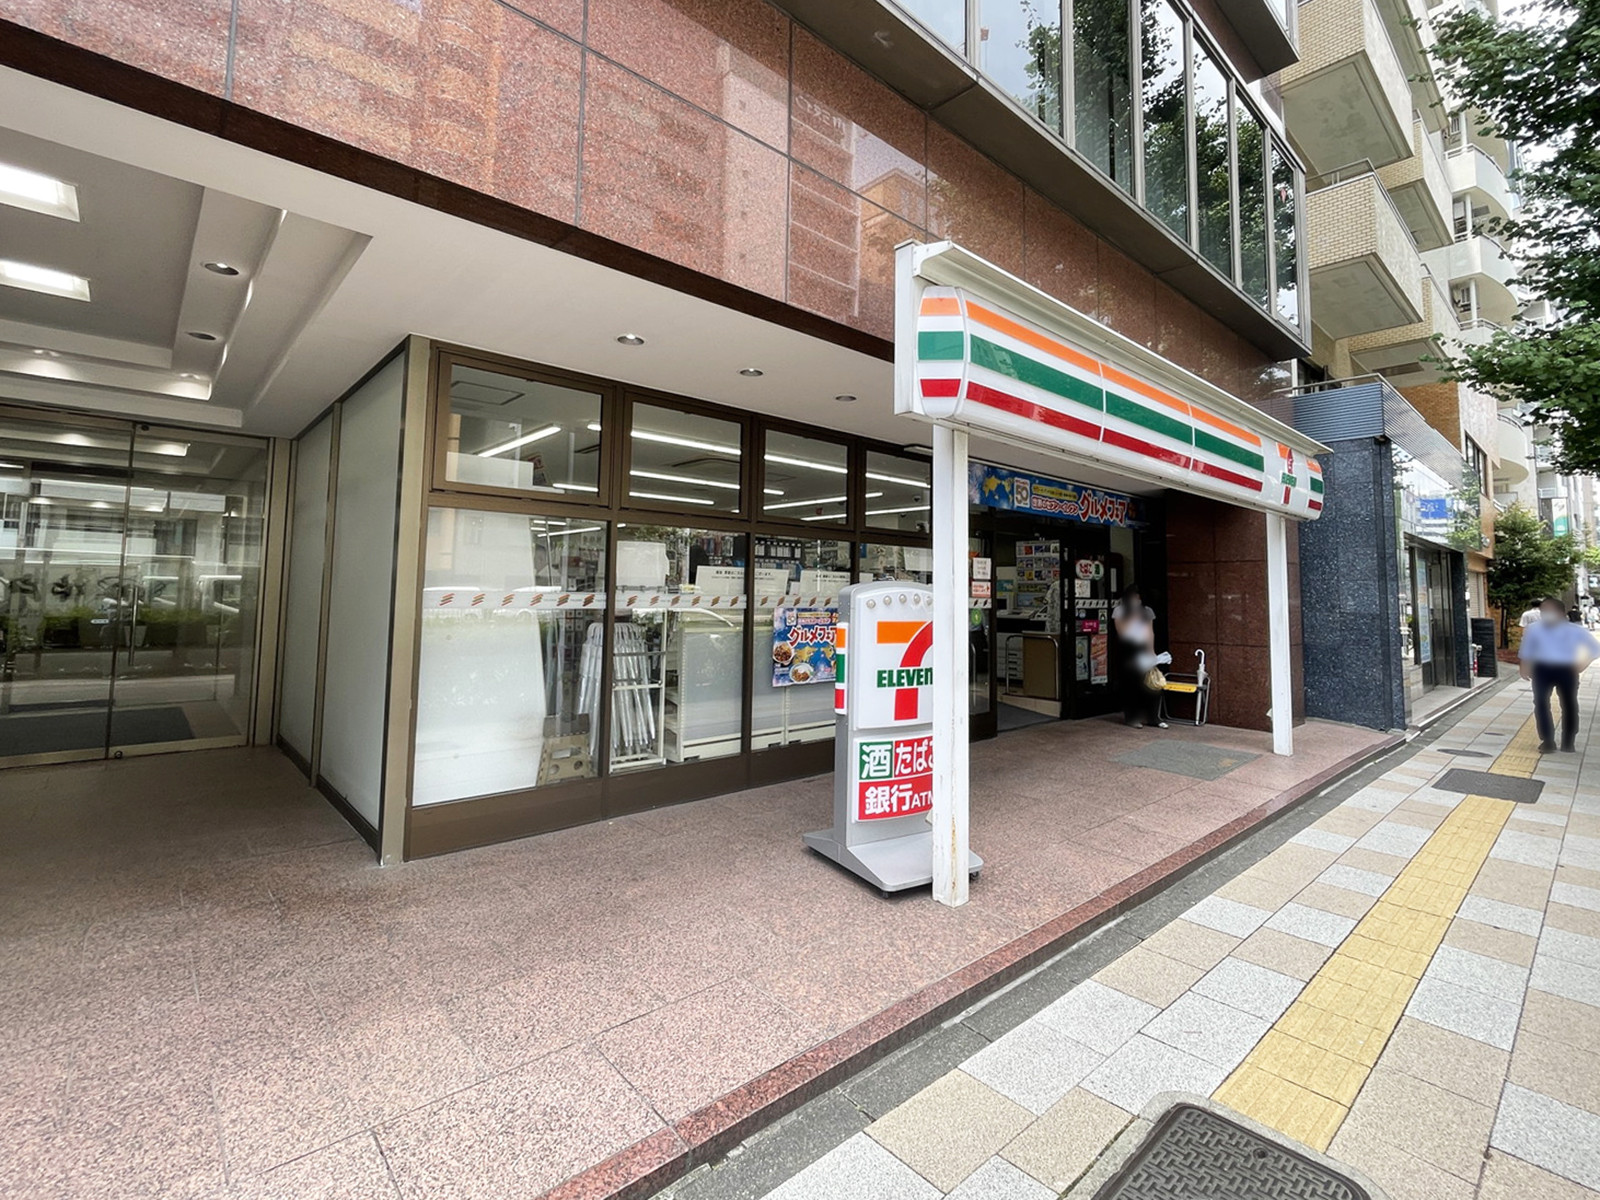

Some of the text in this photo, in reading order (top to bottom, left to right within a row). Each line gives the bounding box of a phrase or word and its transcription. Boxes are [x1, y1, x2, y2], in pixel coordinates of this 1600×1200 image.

[1079, 490, 1127, 525] グルメフェア
[787, 626, 838, 647] グルメフェア
[861, 744, 892, 779] 酒
